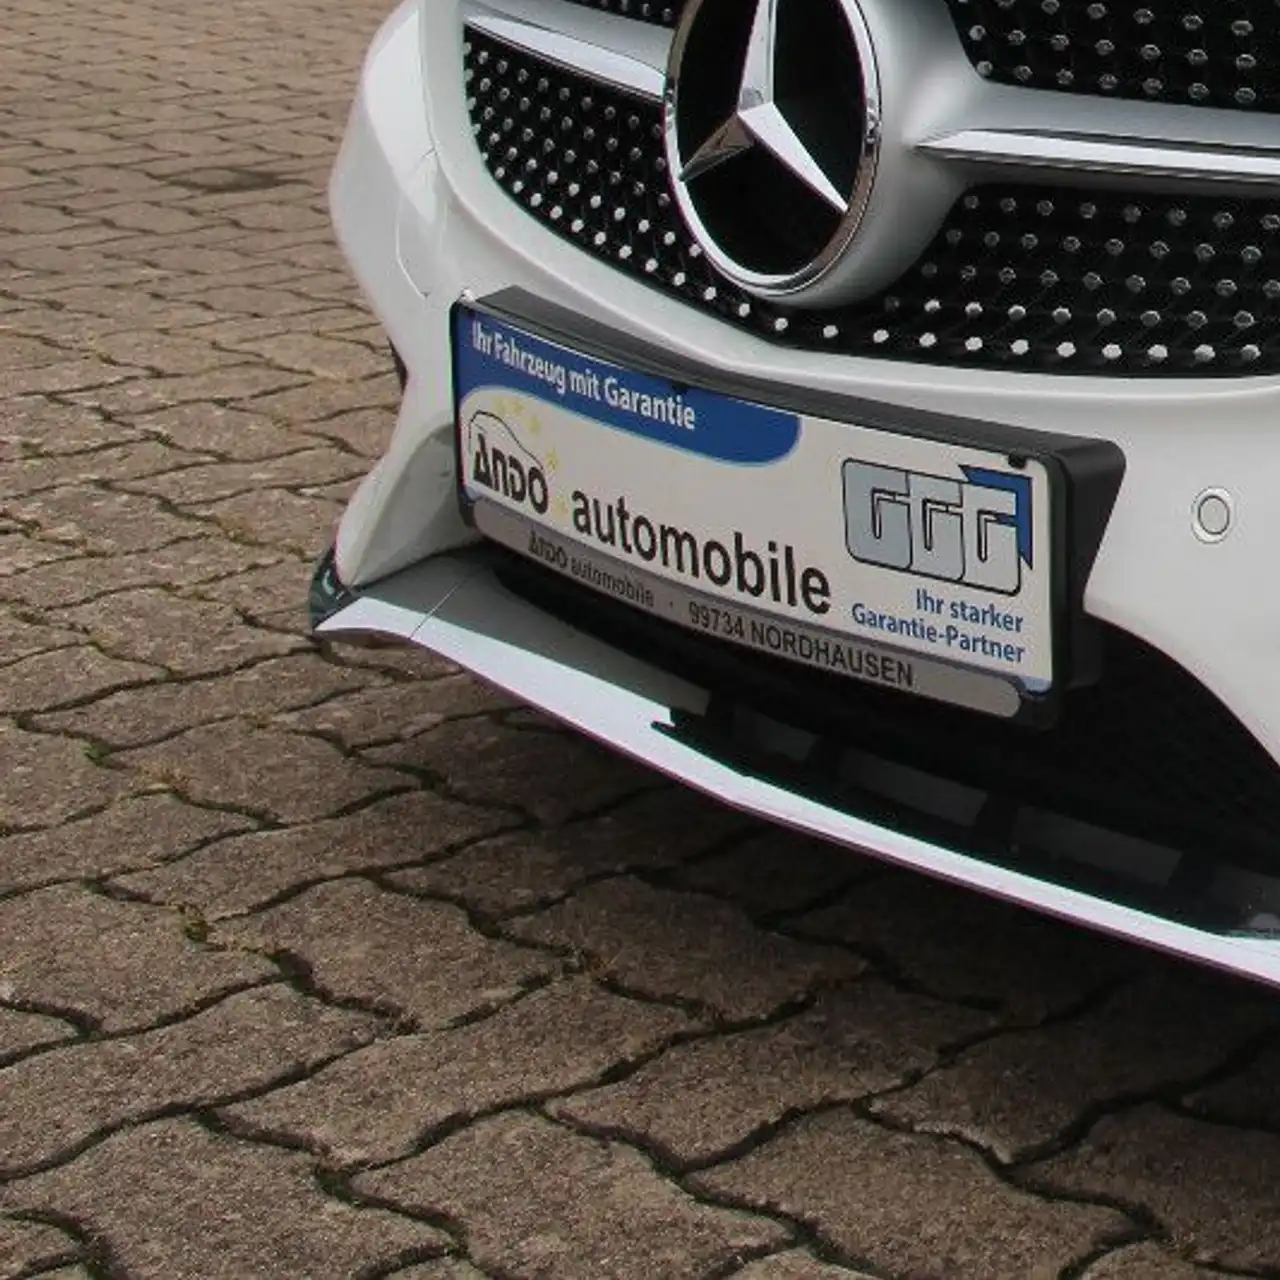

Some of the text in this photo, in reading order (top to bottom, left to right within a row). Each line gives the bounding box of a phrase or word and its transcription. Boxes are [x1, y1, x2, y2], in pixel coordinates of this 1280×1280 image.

[472, 320, 696, 429] Ihr Fahrzeug mit Garantie
[572, 489, 832, 614] automobile
[571, 556, 655, 608] automobile
[688, 600, 746, 639] 99734
[751, 622, 914, 687] NORDHAUSEN
[852, 602, 1026, 663] Garantie-Partner
[916, 588, 1024, 632] Ihr starker
